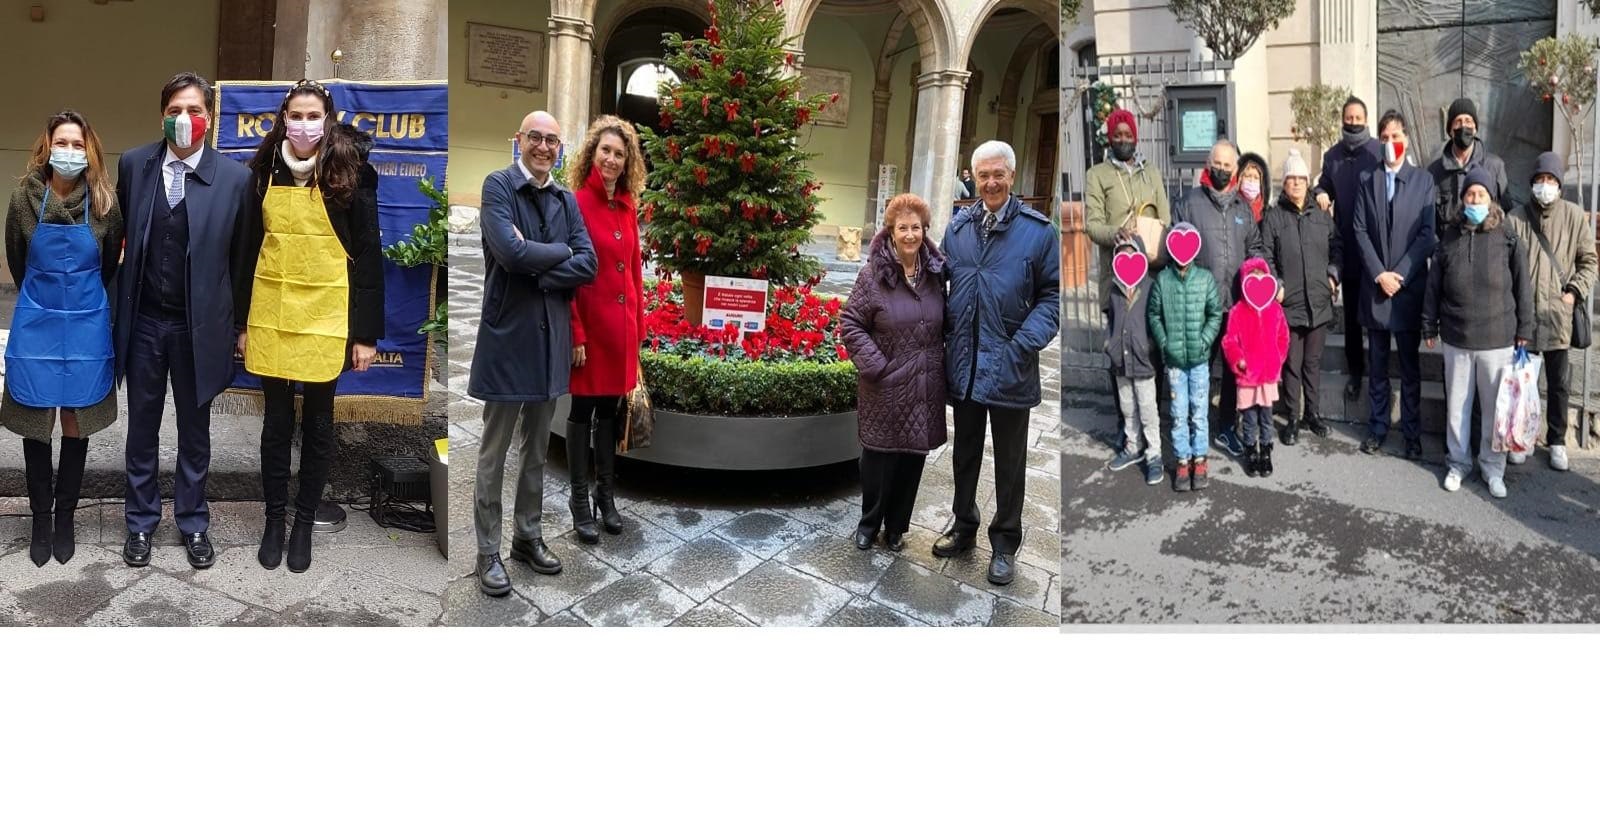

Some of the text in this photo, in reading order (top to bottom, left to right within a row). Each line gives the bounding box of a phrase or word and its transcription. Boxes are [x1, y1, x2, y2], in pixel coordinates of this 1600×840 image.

[352, 113, 426, 139] CLUB
[399, 163, 427, 177] ETNEO
[373, 352, 404, 364] ALTA
